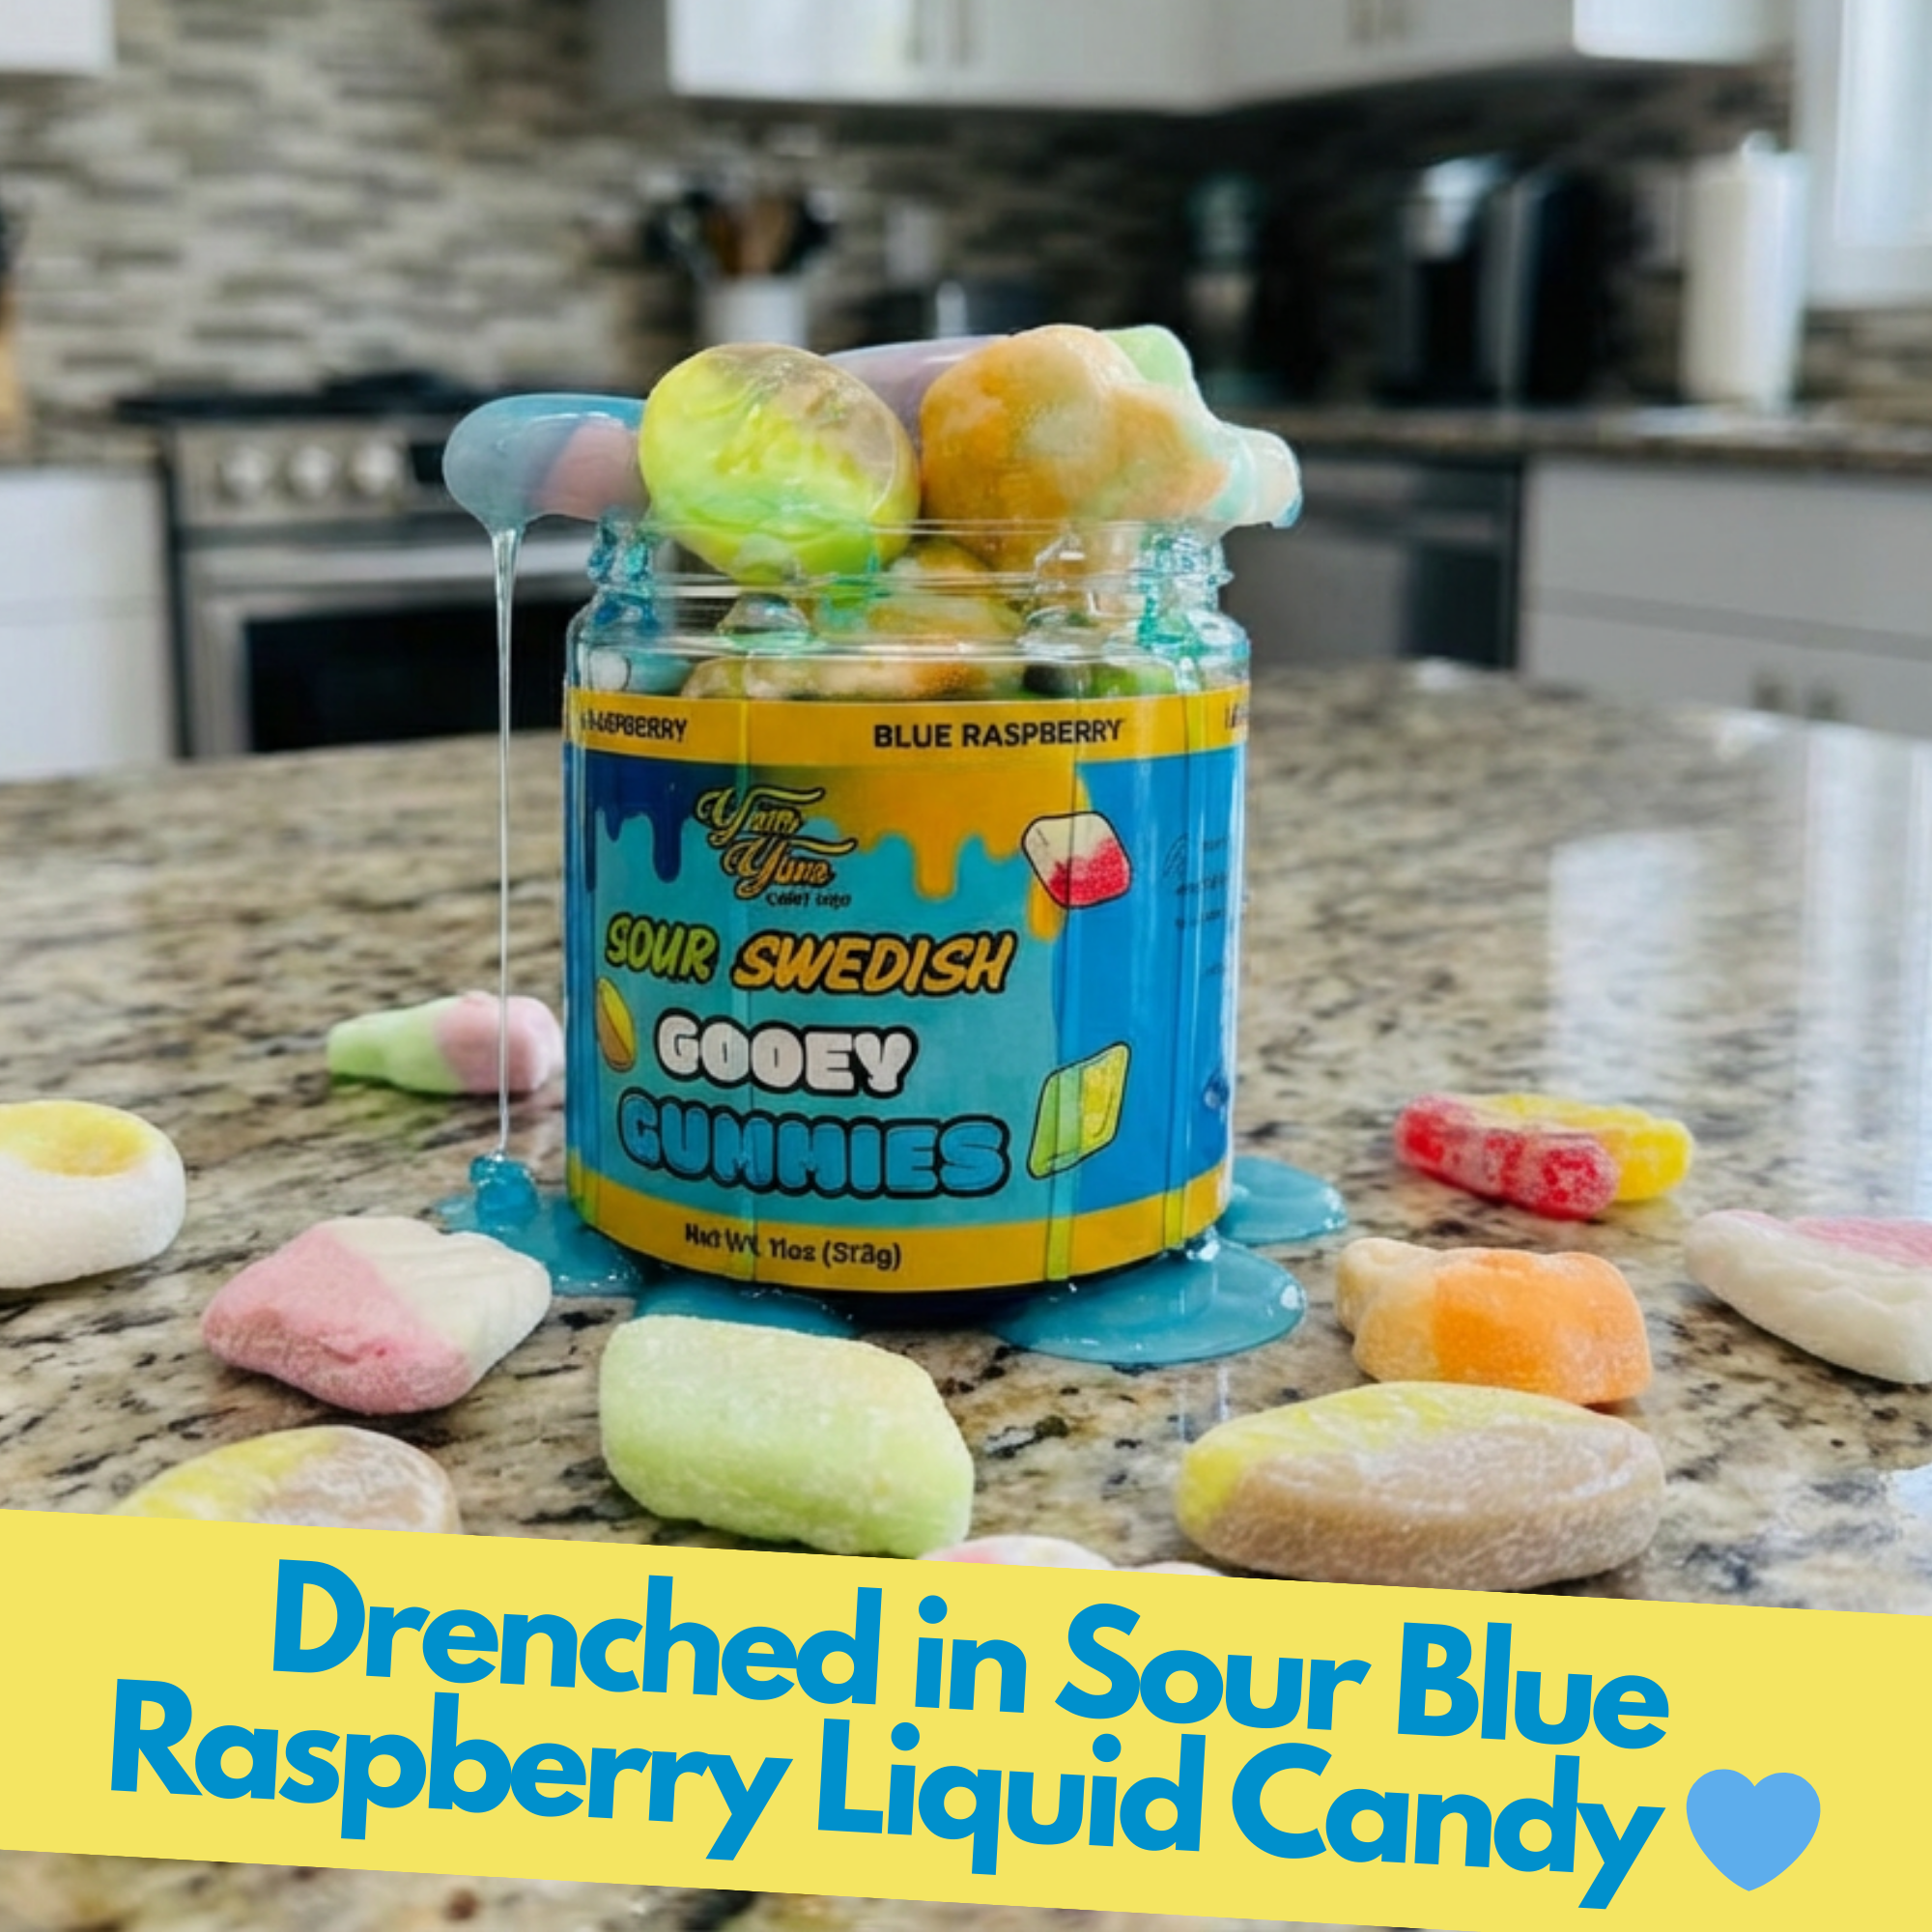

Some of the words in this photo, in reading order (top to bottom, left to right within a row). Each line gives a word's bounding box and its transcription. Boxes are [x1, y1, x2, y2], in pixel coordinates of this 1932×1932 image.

[873, 724, 952, 748] BLUE
[961, 720, 1124, 748] RASPBERRY
[605, 912, 720, 984] SOUR
[729, 930, 1017, 996] SWEDISH
[654, 1008, 919, 1098] GOOEY
[617, 1087, 1010, 1199] GUMMIES
